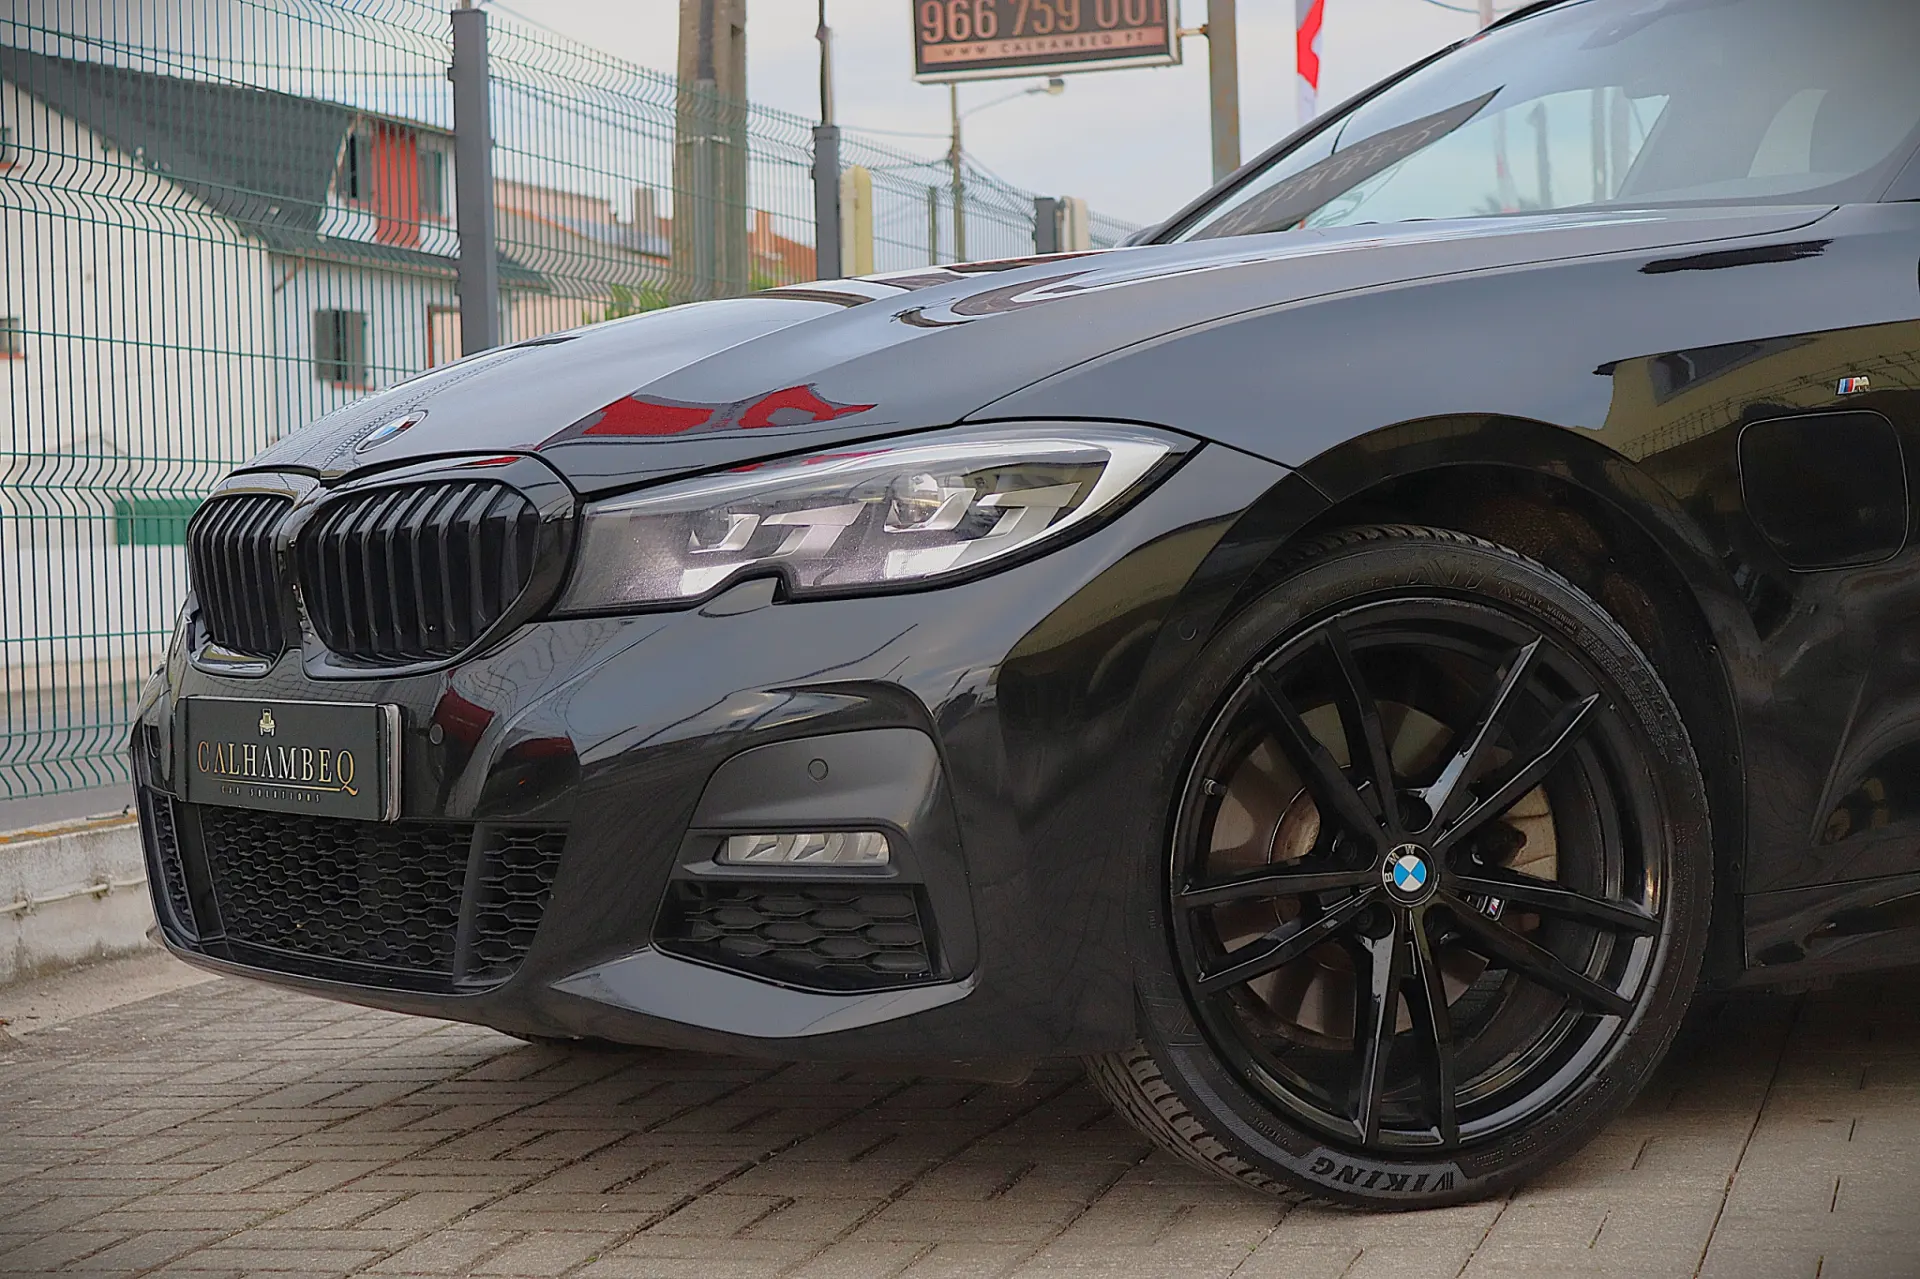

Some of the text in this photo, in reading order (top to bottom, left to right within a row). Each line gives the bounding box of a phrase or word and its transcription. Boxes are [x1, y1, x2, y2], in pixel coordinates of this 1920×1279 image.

[921, 0, 997, 43] 966
[1008, 0, 1080, 36] 759
[197, 741, 358, 796] CALHAMBEQ
[1384, 845, 1415, 883] BMW
[1309, 1156, 1454, 1193] VIKING
